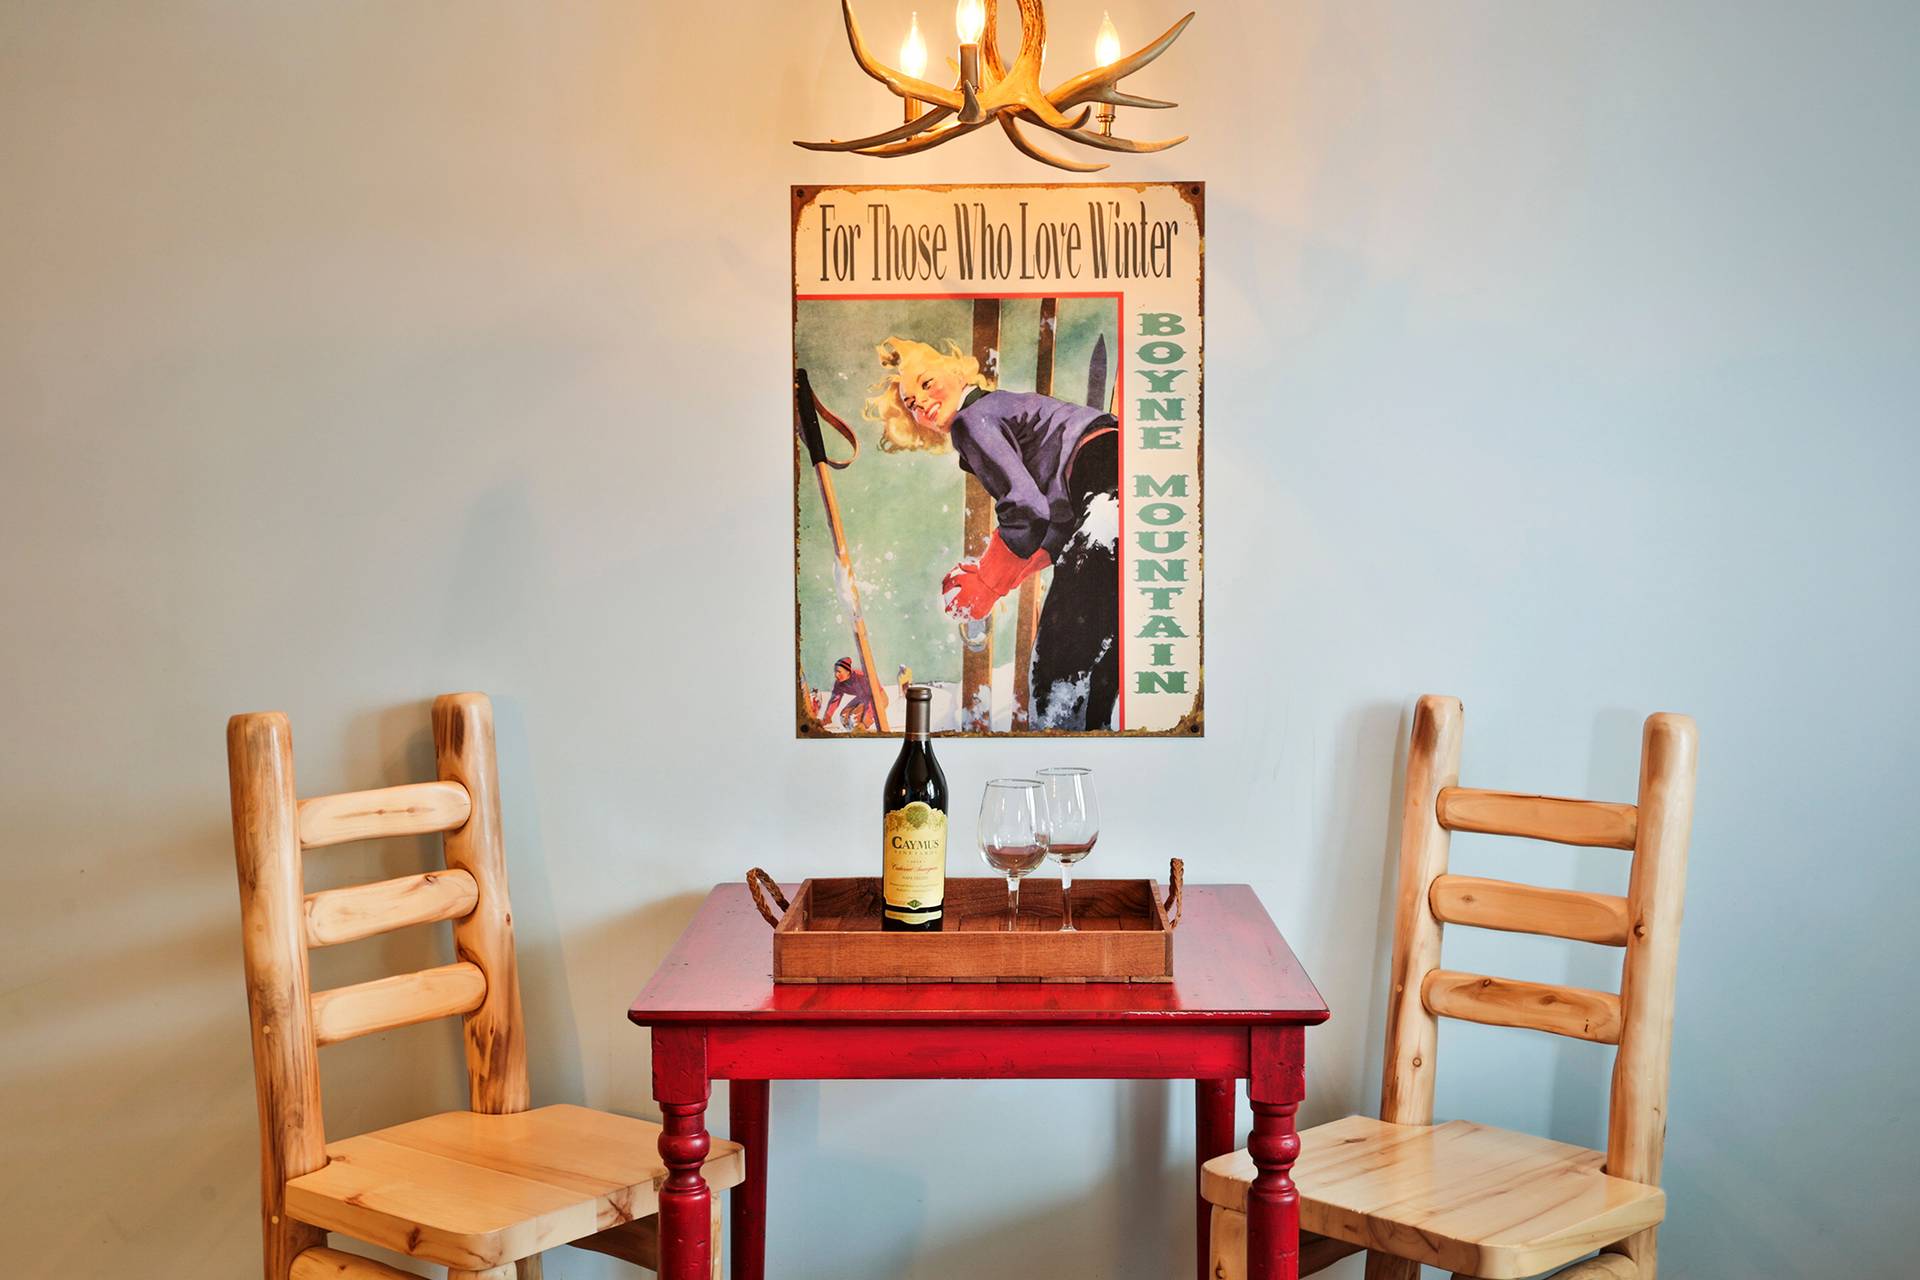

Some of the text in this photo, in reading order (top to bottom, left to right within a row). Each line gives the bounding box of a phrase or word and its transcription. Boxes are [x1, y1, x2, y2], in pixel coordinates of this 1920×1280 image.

[819, 200, 1178, 282] For Those Who Love Winter
[1133, 312, 1189, 695] BOYNE MOUNTAIN
[891, 836, 940, 849] CAYMUS
